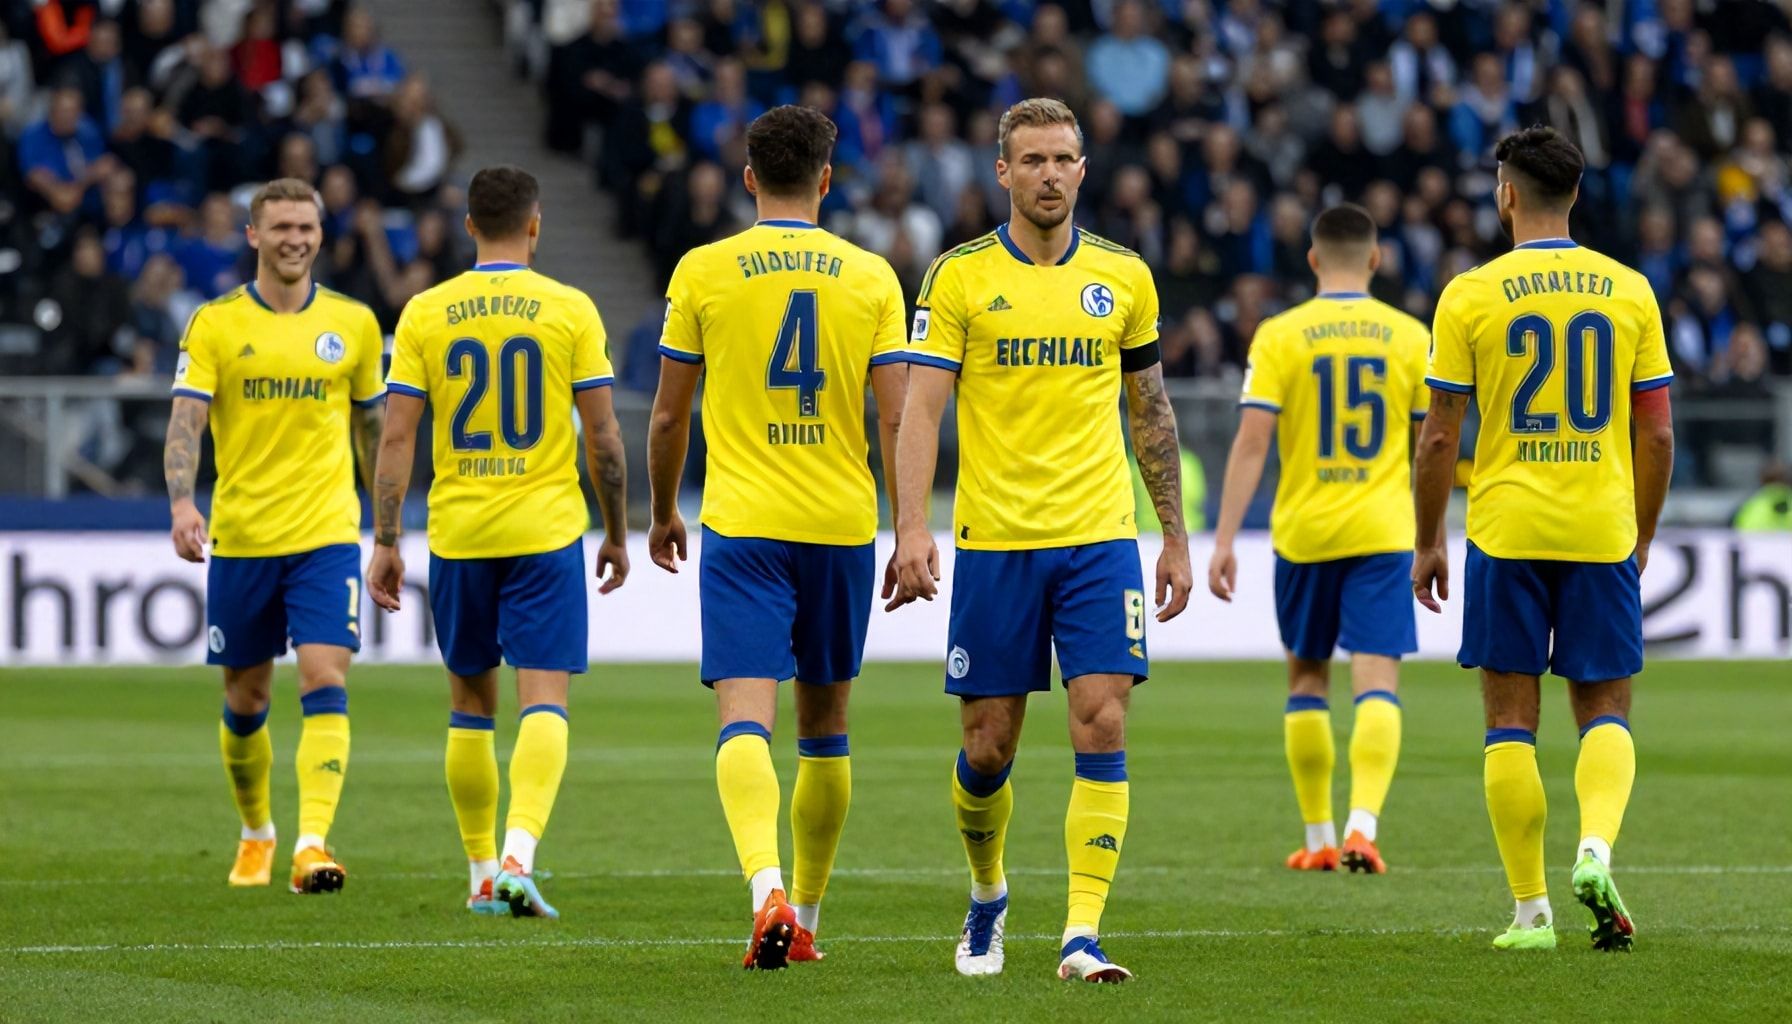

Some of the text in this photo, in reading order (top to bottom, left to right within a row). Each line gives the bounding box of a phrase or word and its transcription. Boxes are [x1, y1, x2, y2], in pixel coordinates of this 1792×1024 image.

[446, 335, 545, 451] 20
[766, 289, 826, 418] 4
[1312, 356, 1387, 461] 15
[1506, 310, 1615, 433] 20
